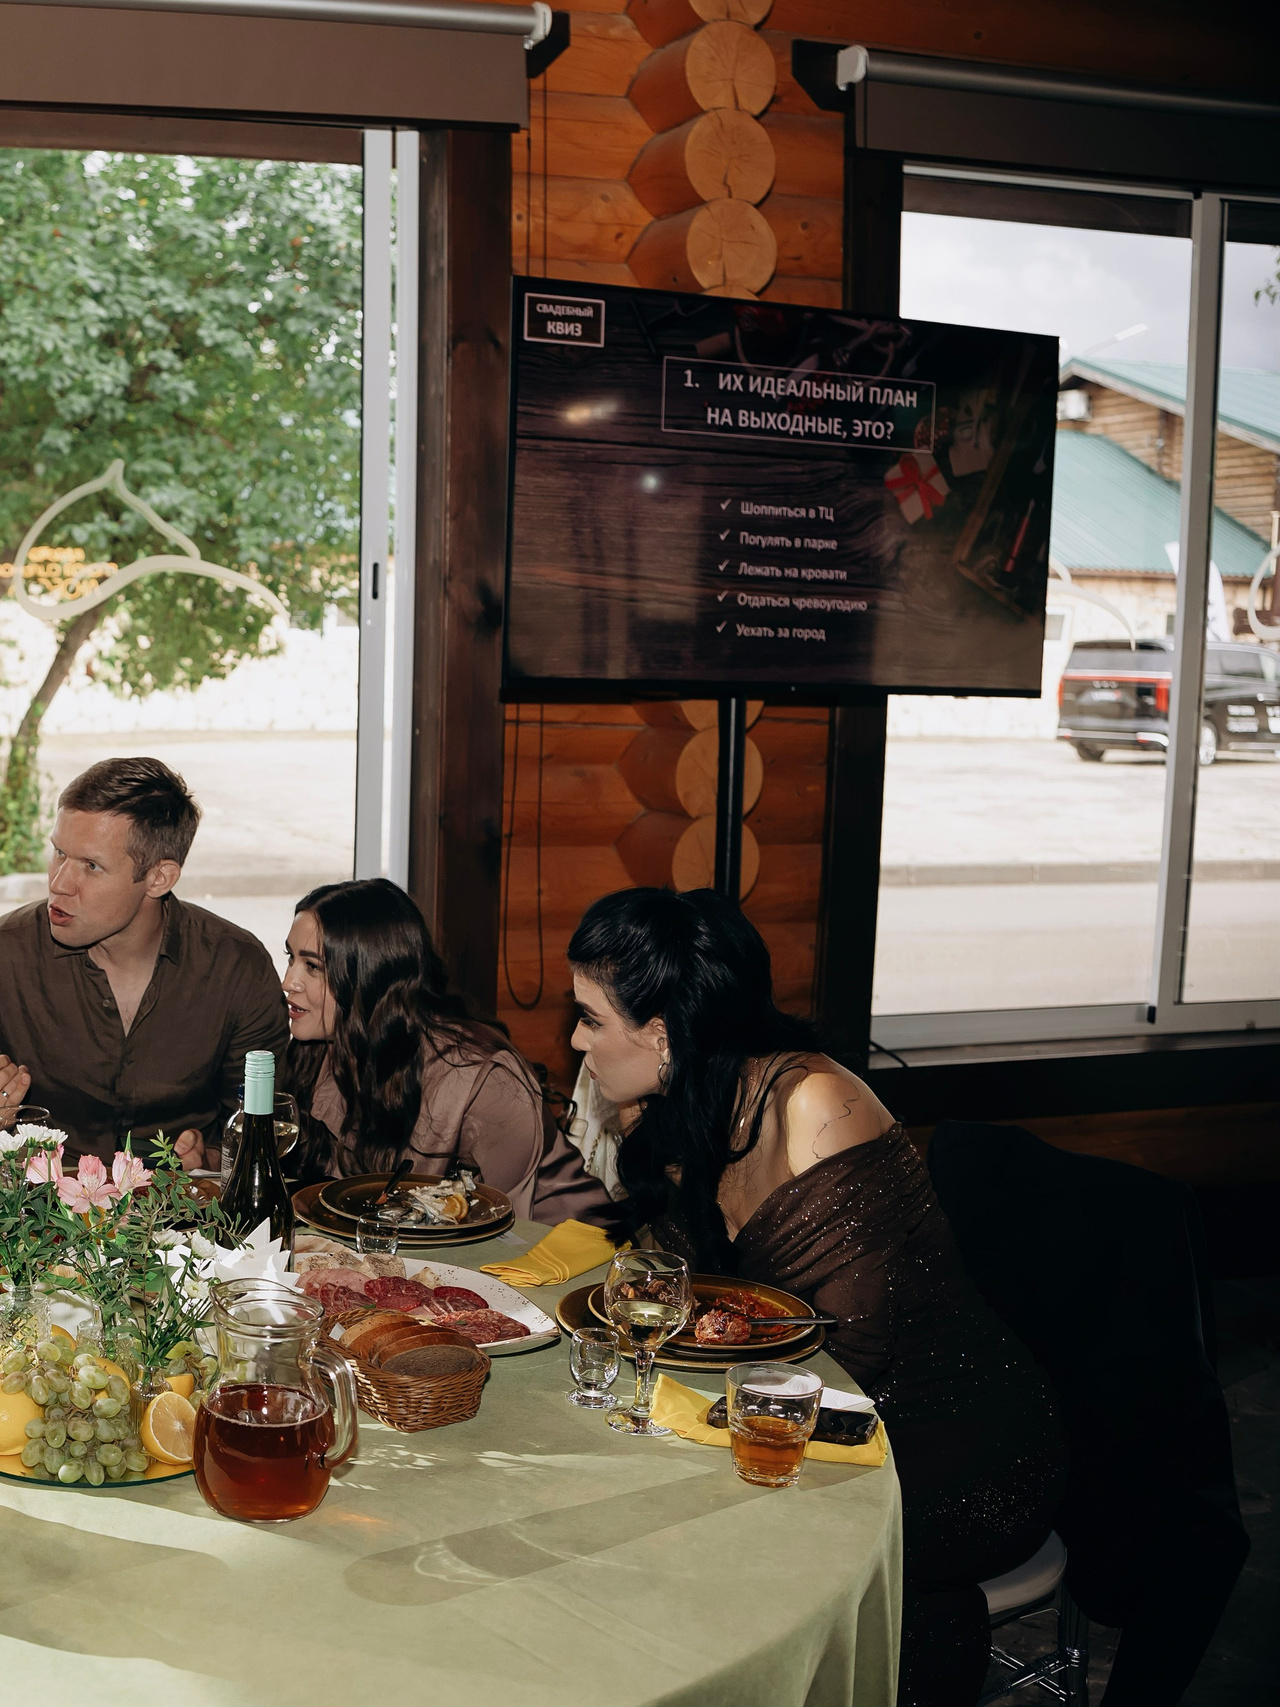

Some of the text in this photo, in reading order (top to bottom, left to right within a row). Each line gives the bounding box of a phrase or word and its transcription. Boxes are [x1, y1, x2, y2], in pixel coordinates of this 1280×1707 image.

[536, 303, 593, 318] СВАДЕБНЫЙ
[547, 320, 582, 337] КВИЗ
[683, 369, 918, 408] 1. ИХ ИДЕАЛЬНЫЙ ПЛАН
[706, 407, 894, 440] НА ВЫХОДНЫЕ, ЭТО?
[740, 501, 835, 522] Шоппиться в ТЦ
[739, 531, 838, 552] Погулять в парке
[738, 562, 847, 581] Лежать на кровати
[737, 592, 868, 612] Отдаться чревоугодию
[736, 623, 826, 642] Уехать за город
